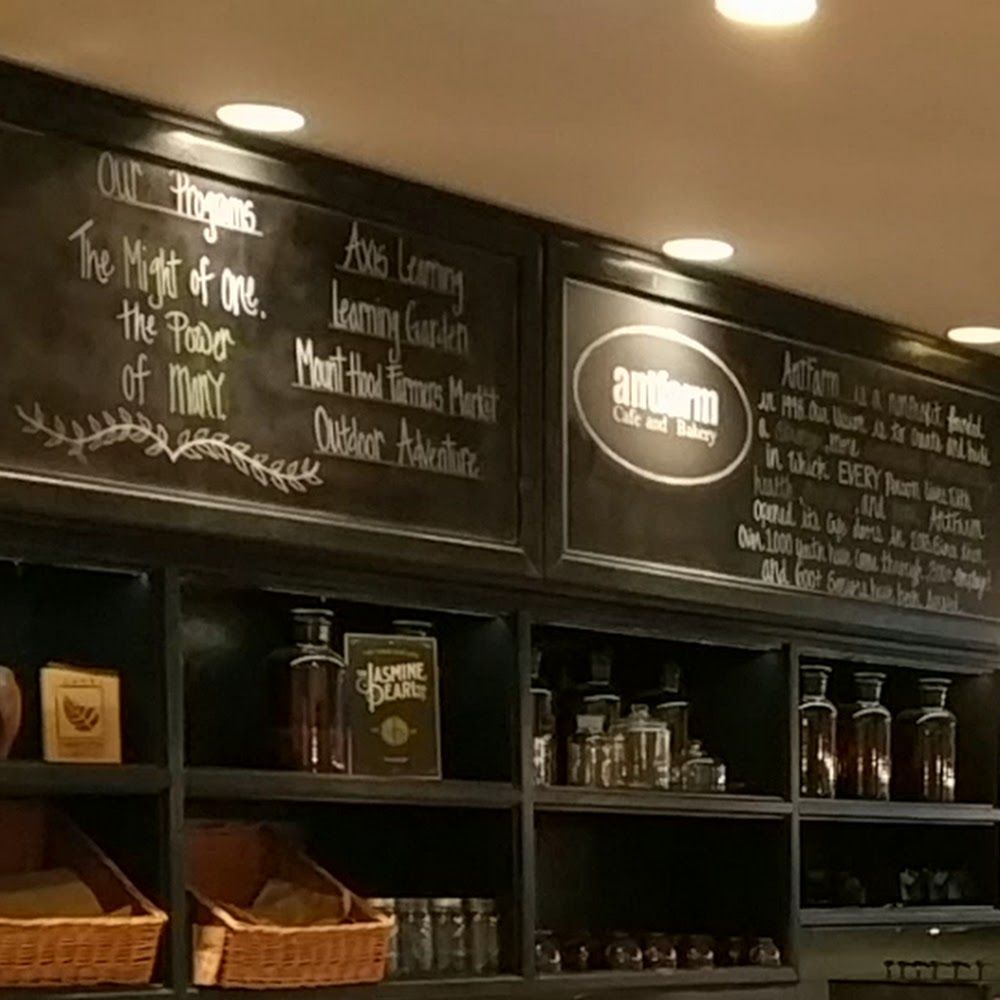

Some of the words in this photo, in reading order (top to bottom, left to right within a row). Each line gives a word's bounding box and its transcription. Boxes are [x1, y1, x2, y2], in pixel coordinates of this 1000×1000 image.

[68, 219, 115, 284] The
[123, 236, 182, 310] Might
[190, 255, 215, 307] of
[344, 220, 389, 280] Axis
[398, 236, 465, 317] Learning
[165, 309, 235, 364] Power
[331, 277, 400, 365] Learning
[405, 299, 470, 354] Garden
[121, 354, 150, 404] of
[295, 335, 348, 392] Mount
[345, 350, 384, 400] Hood
[314, 404, 385, 462] Outdoor
[645, 415, 668, 434] and
[675, 417, 718, 448] Bakery
[837, 459, 882, 491] EVERY
[357, 661, 428, 693] JASMINE
[366, 680, 418, 714] PEARL
